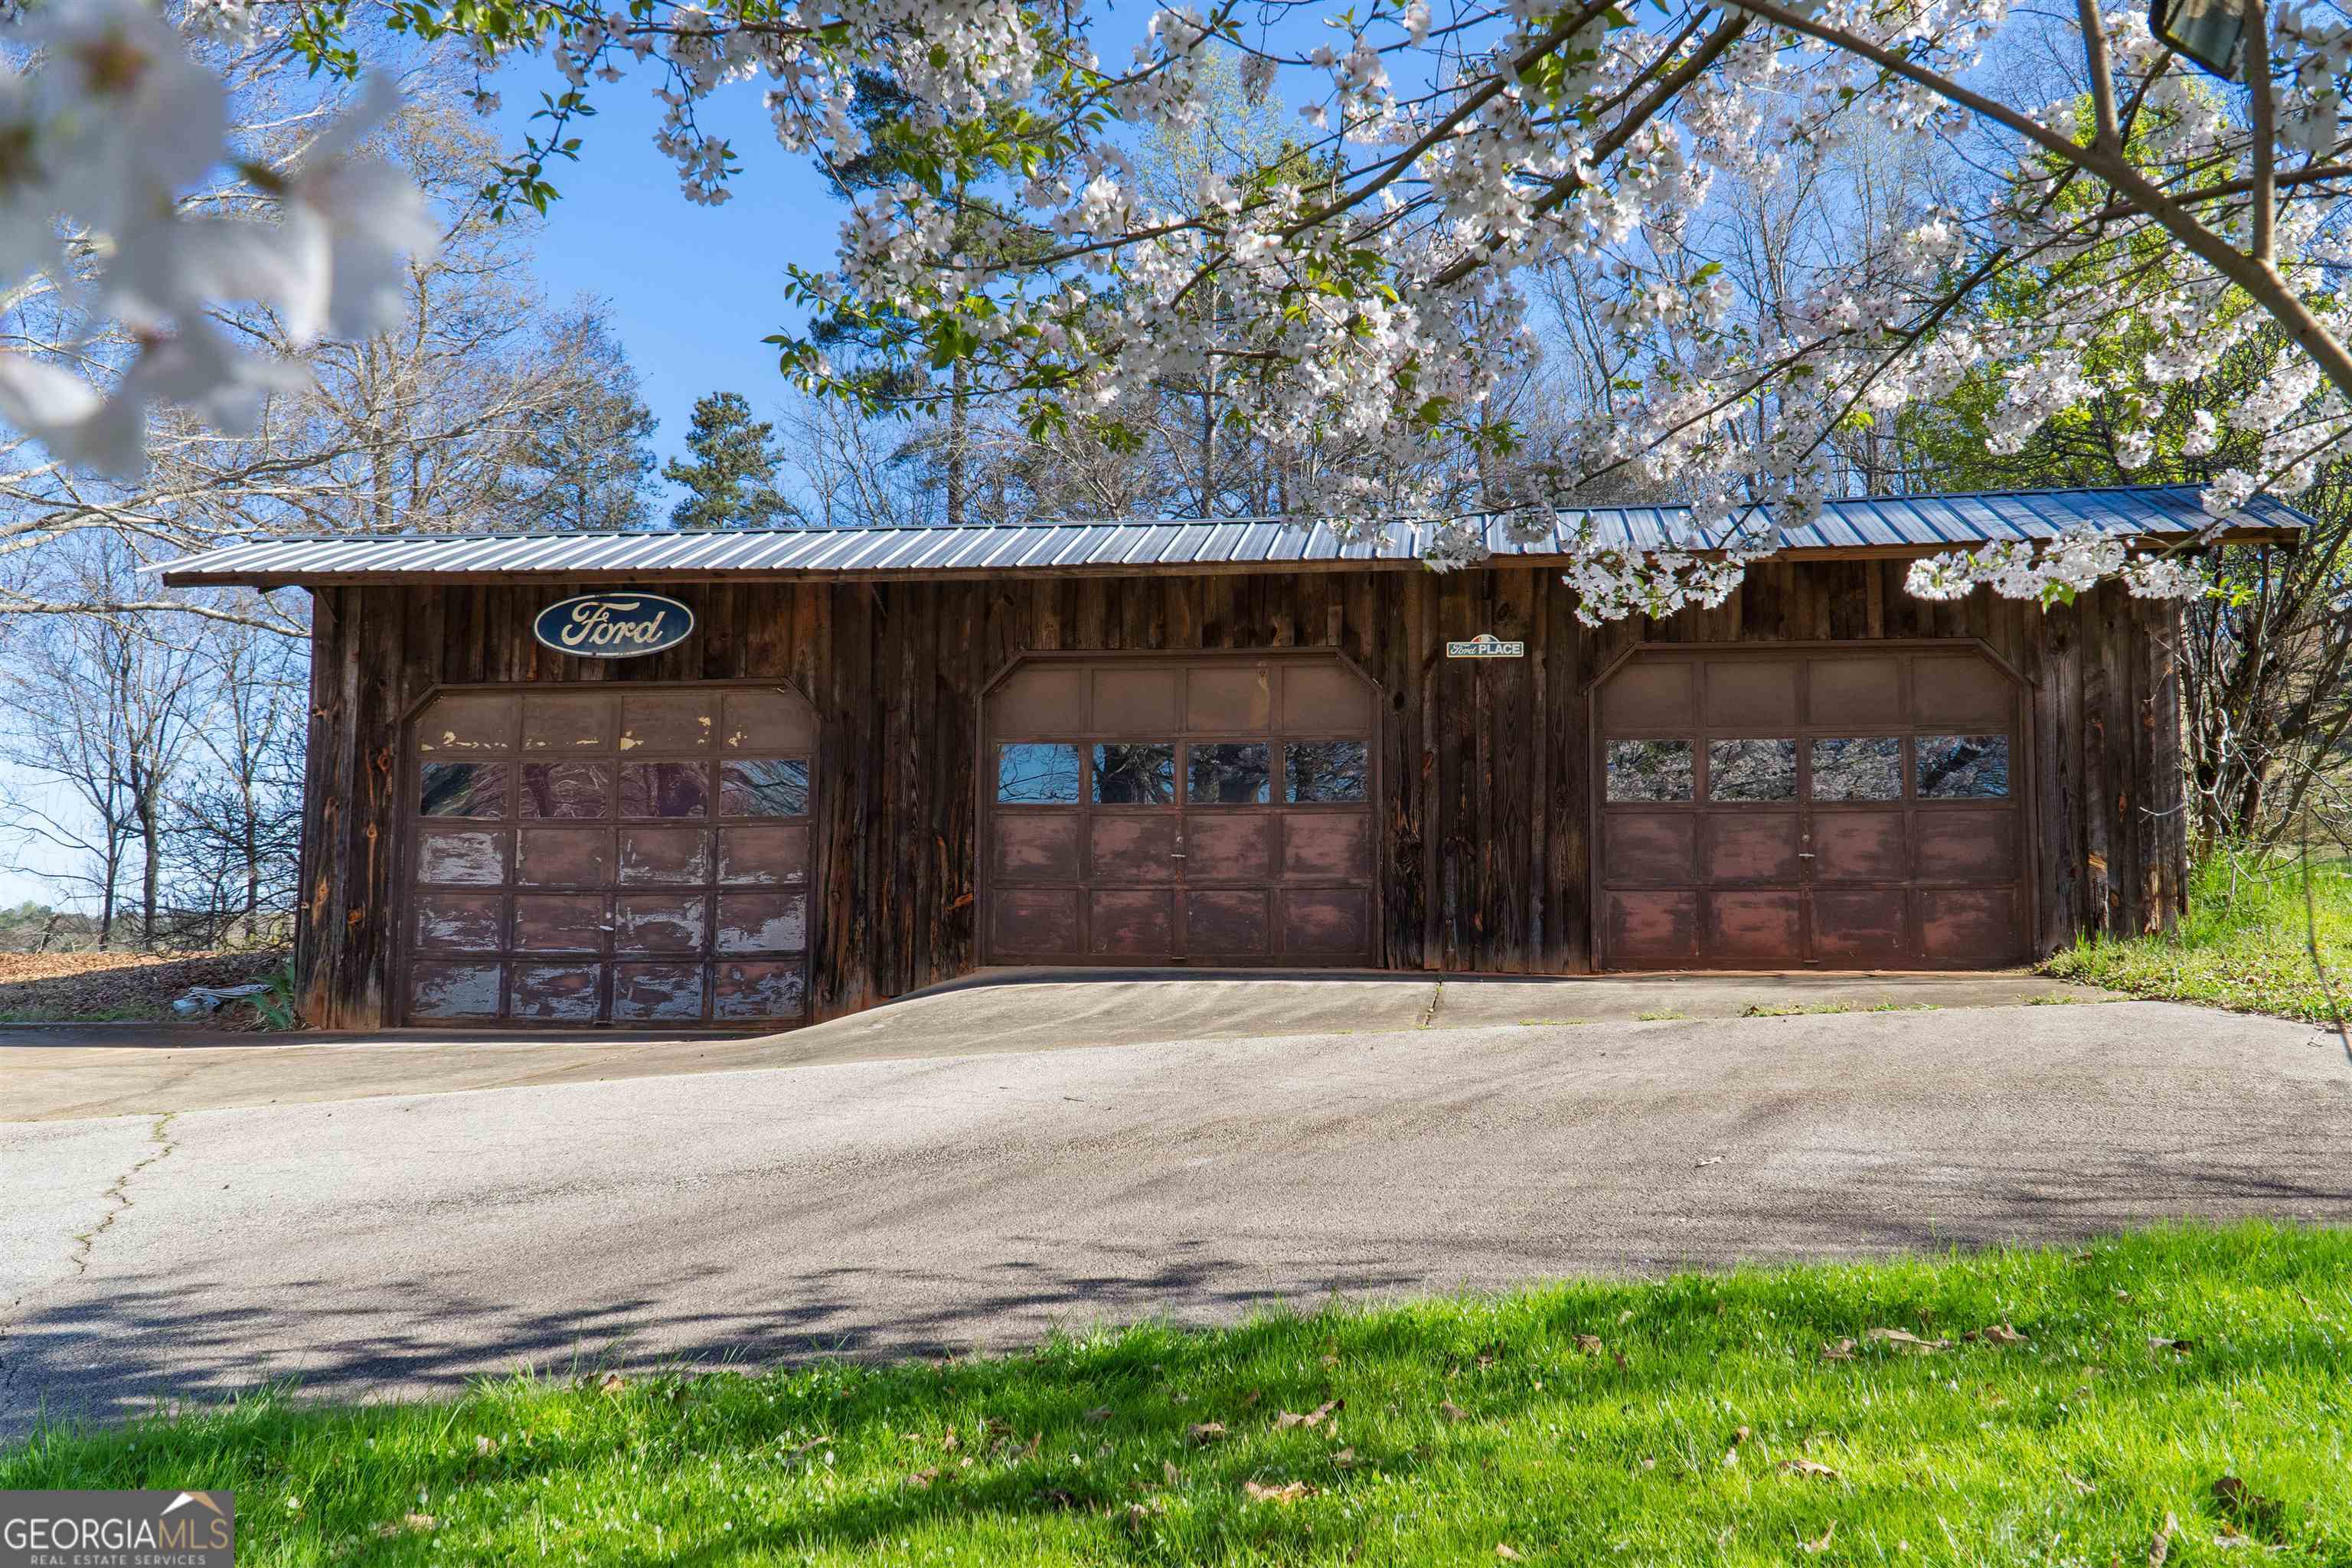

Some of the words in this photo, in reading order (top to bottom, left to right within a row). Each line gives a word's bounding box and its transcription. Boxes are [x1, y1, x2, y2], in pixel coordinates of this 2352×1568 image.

[561, 602, 666, 645] Ford
[1450, 643, 1477, 655] Ford
[1478, 644, 1521, 654] PLACE
